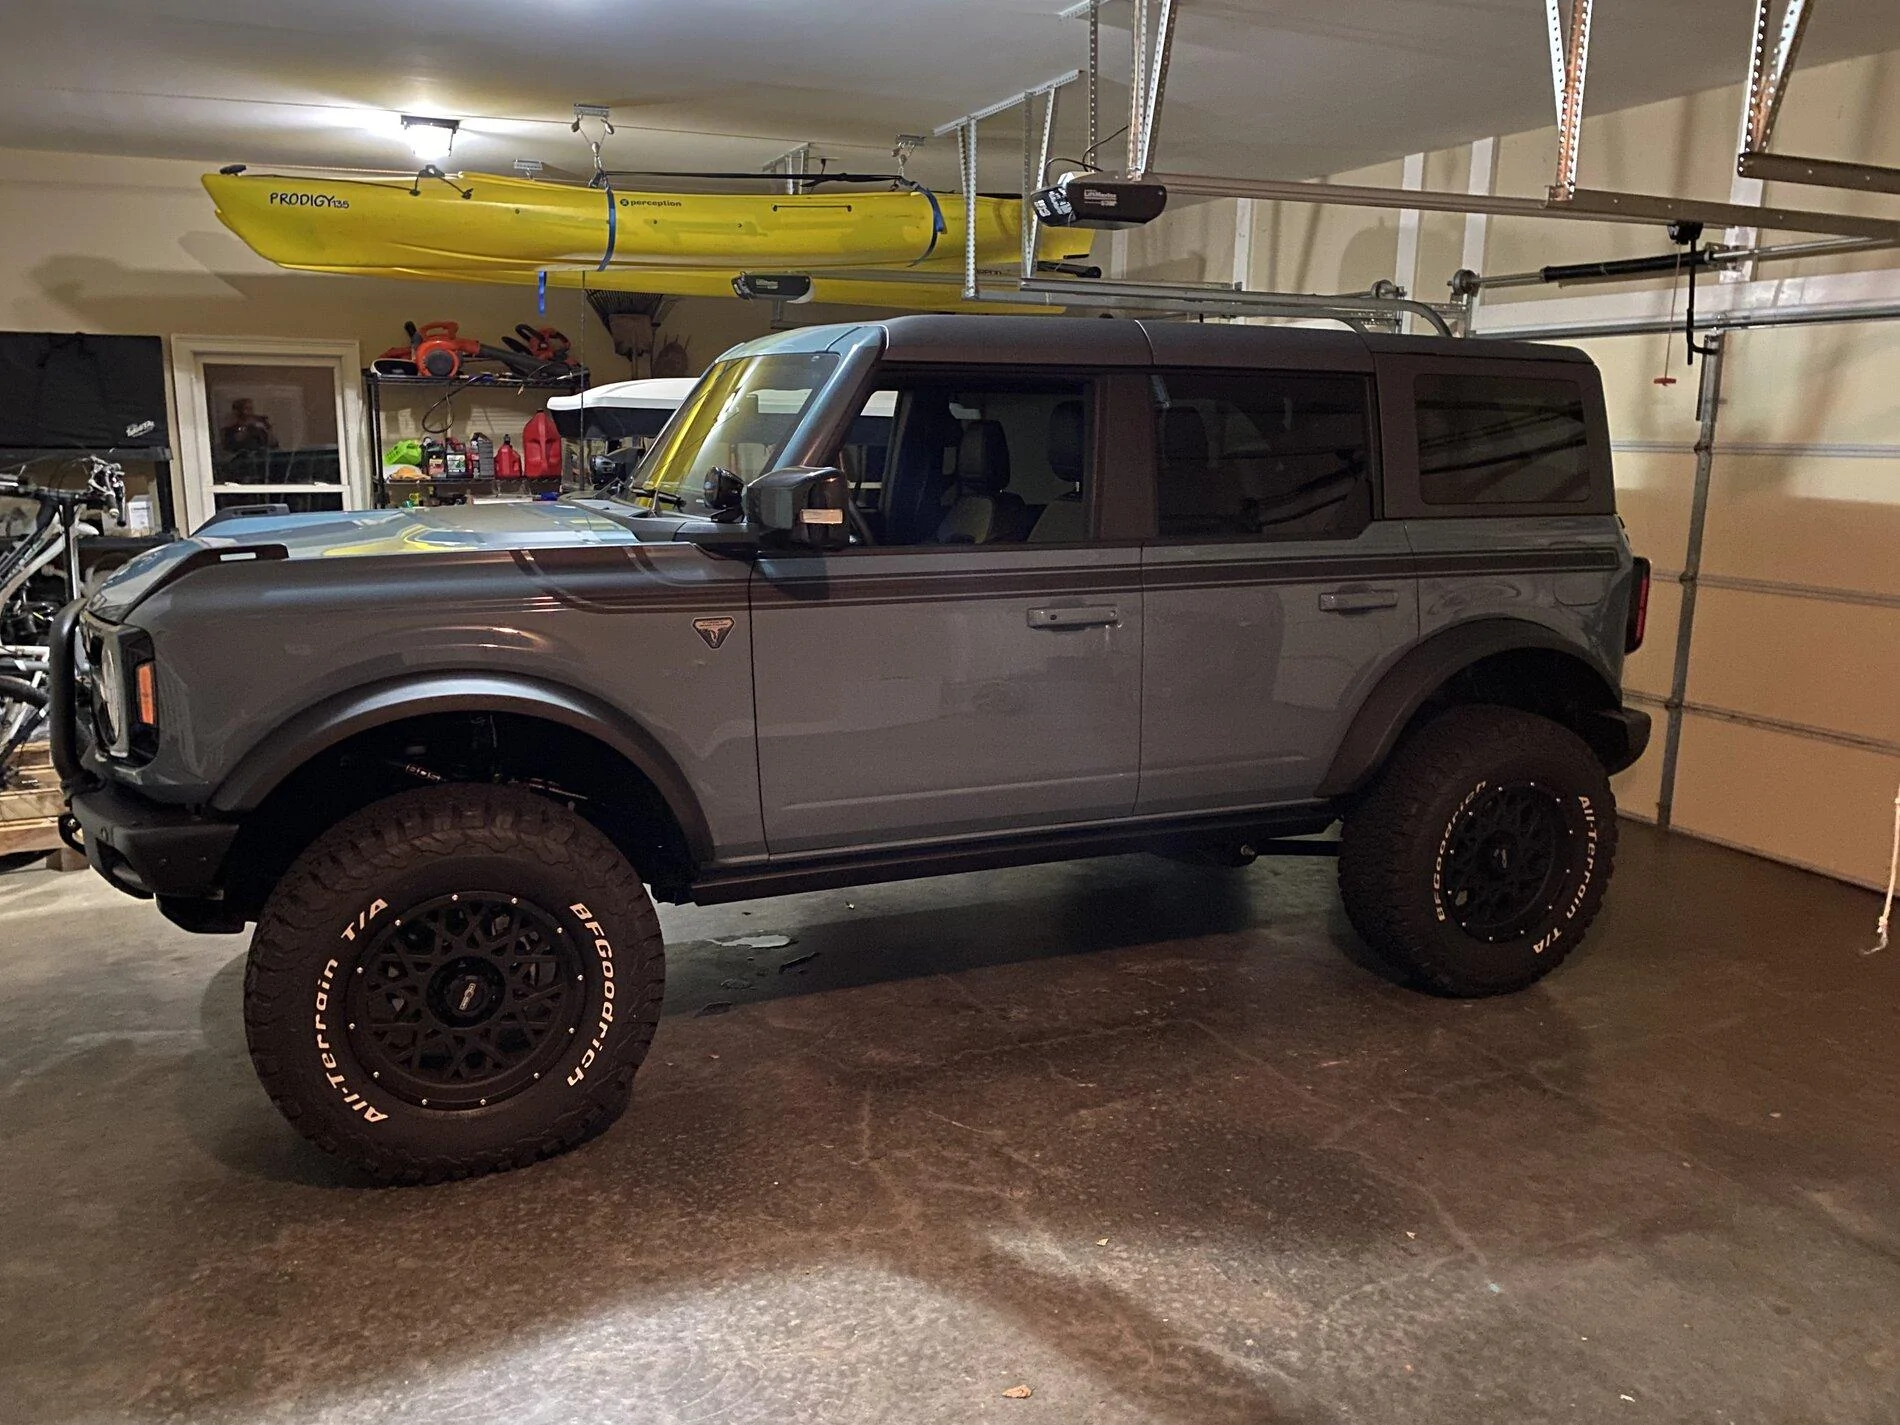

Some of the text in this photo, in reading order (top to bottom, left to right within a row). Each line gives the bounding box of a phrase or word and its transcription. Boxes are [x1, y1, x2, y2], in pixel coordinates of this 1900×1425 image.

[269, 192, 335, 208] PRODIGY
[630, 199, 682, 207] perception
[1433, 780, 1487, 921] BFGoodrich
[1532, 796, 1598, 954] All-Terrain T/A
[315, 897, 389, 1123] All-Terrain T/A
[569, 902, 615, 1087] BFGoodrich
